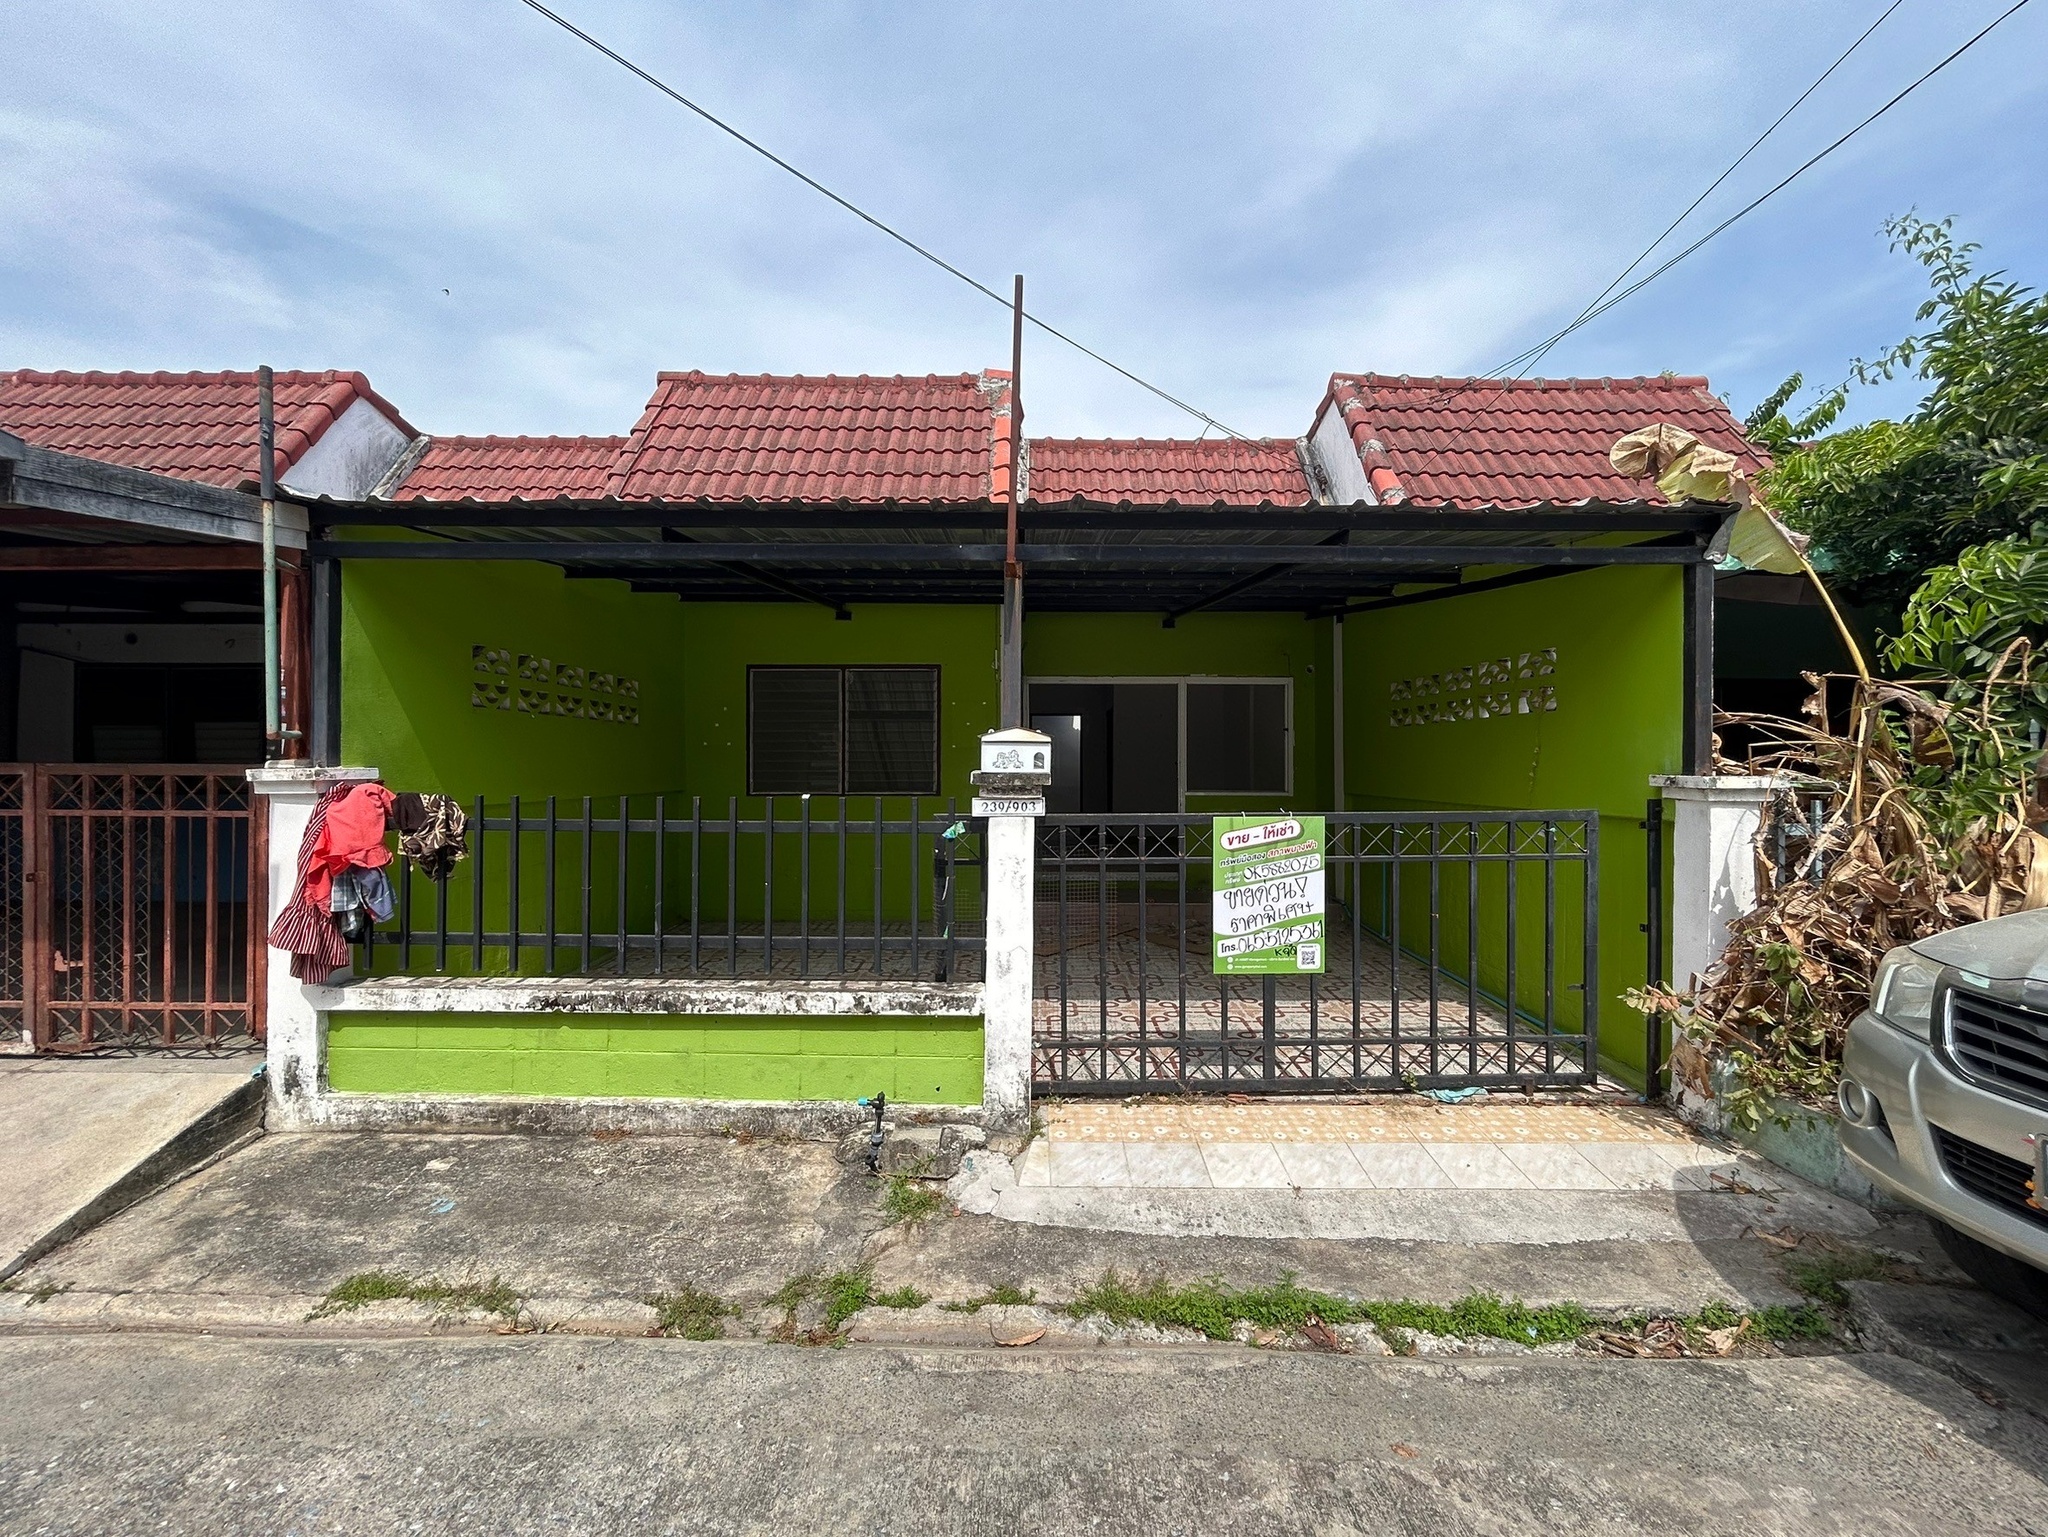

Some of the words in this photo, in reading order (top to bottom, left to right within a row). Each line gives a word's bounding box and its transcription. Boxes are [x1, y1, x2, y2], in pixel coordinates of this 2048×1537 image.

[981, 800, 1036, 813] 239/903
[1226, 833, 1250, 846] ขาย
[1262, 822, 1294, 840] ให้เช่า
[1220, 852, 1266, 868] ทรัพย์มือสอง
[1267, 840, 1318, 858] สภาพนางฟ้า
[1223, 876, 1308, 909] ขายด่วน!
[1230, 901, 1314, 933] ราคาพิเศษ
